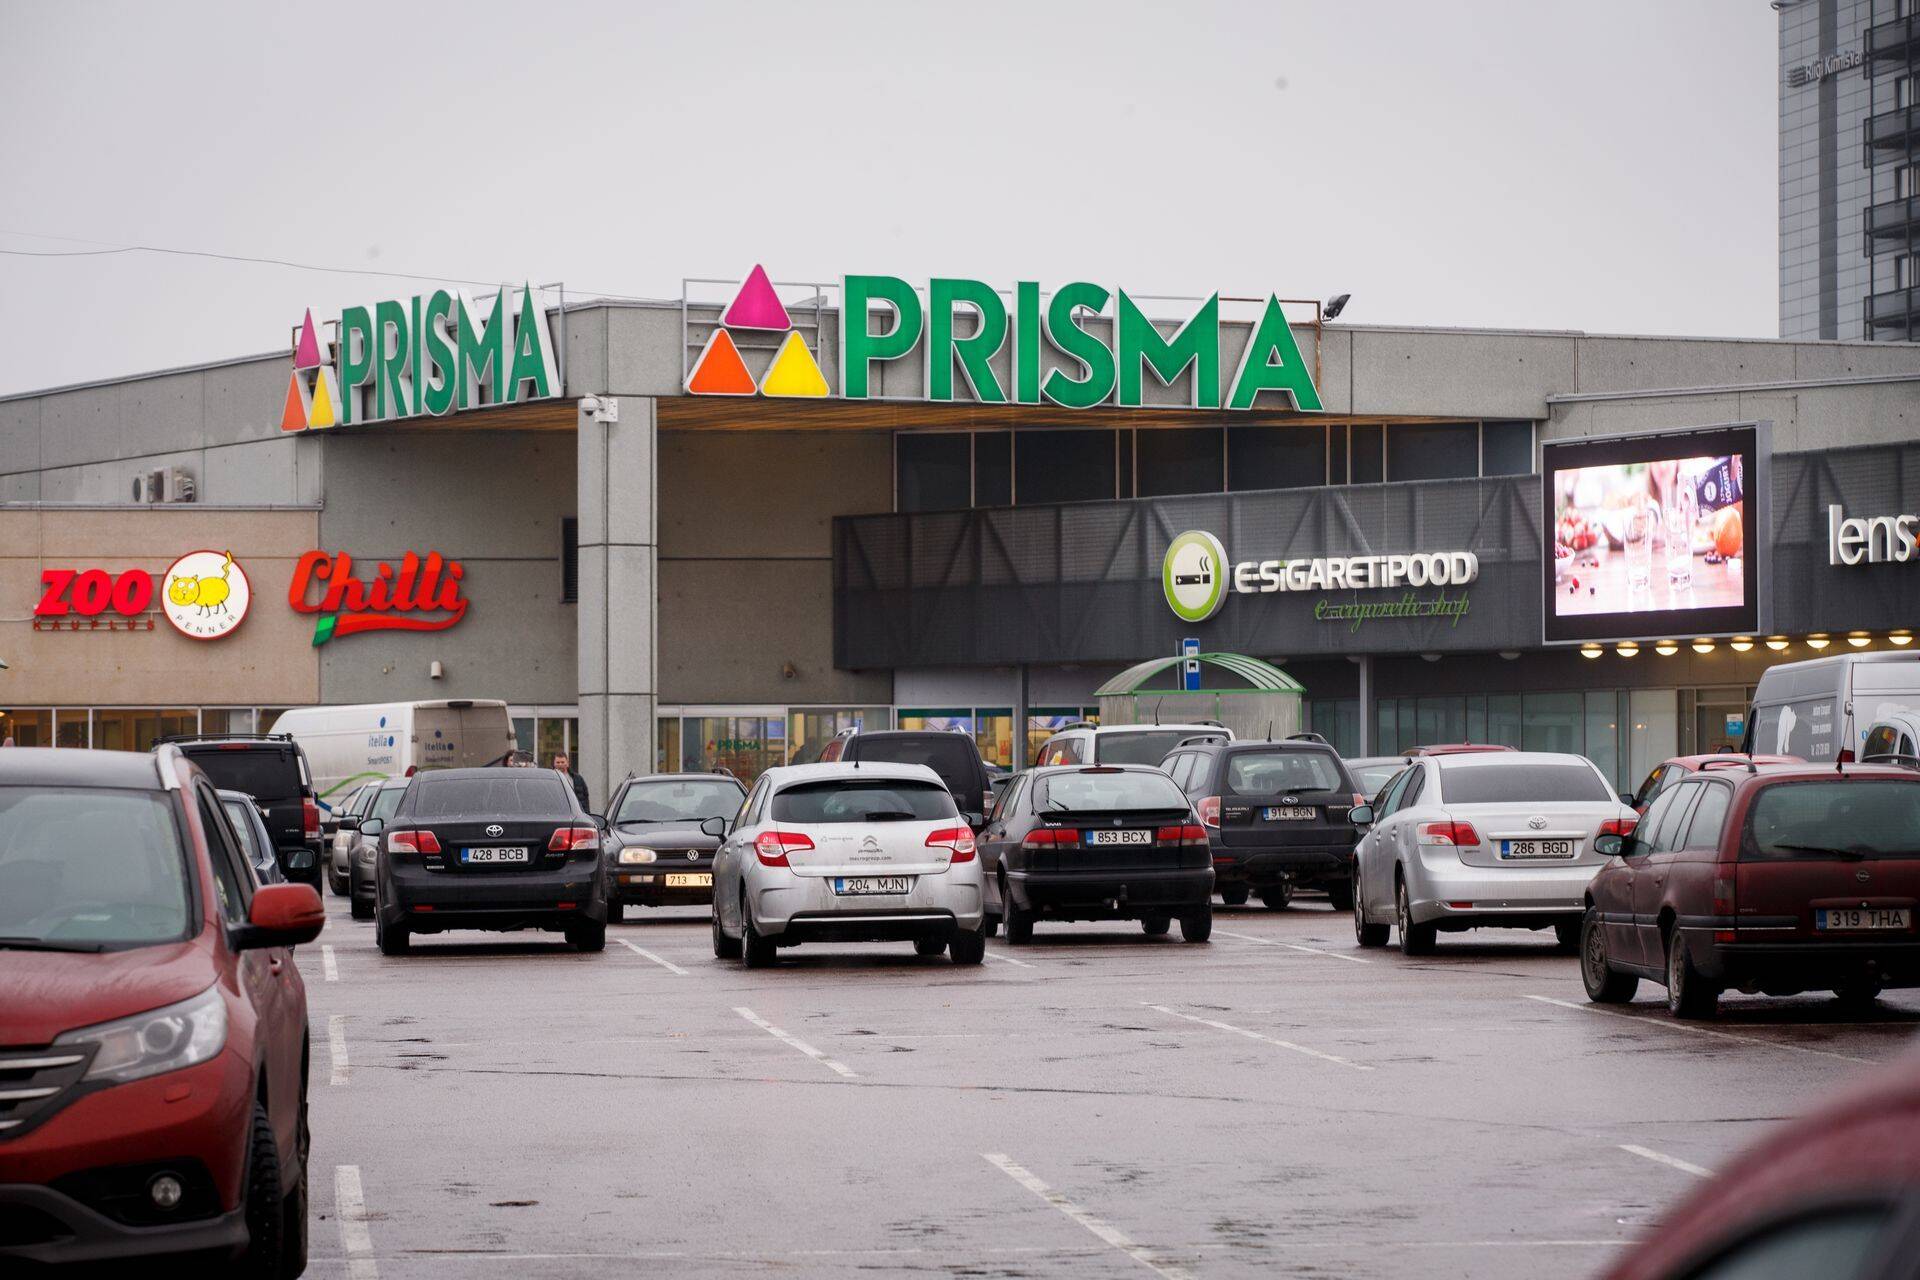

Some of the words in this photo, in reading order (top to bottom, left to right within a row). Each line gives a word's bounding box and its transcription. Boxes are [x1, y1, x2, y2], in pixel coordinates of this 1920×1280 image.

[1824, 49, 1865, 75] Kinnisvar
[840, 273, 1325, 412] PRISMA
[341, 279, 562, 427] PRISMA
[288, 550, 469, 613] Chilli
[34, 568, 154, 617] ZOO
[32, 620, 155, 631] KAUPLUS
[176, 613, 236, 634] PENNER
[368, 734, 388, 748] itella
[1271, 807, 1288, 817] 914
[1293, 807, 1313, 817] BGN
[1097, 832, 1118, 843] 853
[1122, 832, 1147, 843] BCX
[472, 849, 493, 860] 428
[499, 849, 524, 860] BCB
[1513, 842, 1535, 854] 286
[1542, 842, 1569, 854] BGD
[670, 876, 687, 884] 713
[698, 876, 712, 884] TV
[848, 880, 870, 891] 204
[878, 879, 904, 890] MJN
[1832, 912, 1860, 926] 319
[1869, 911, 1904, 926] THA
